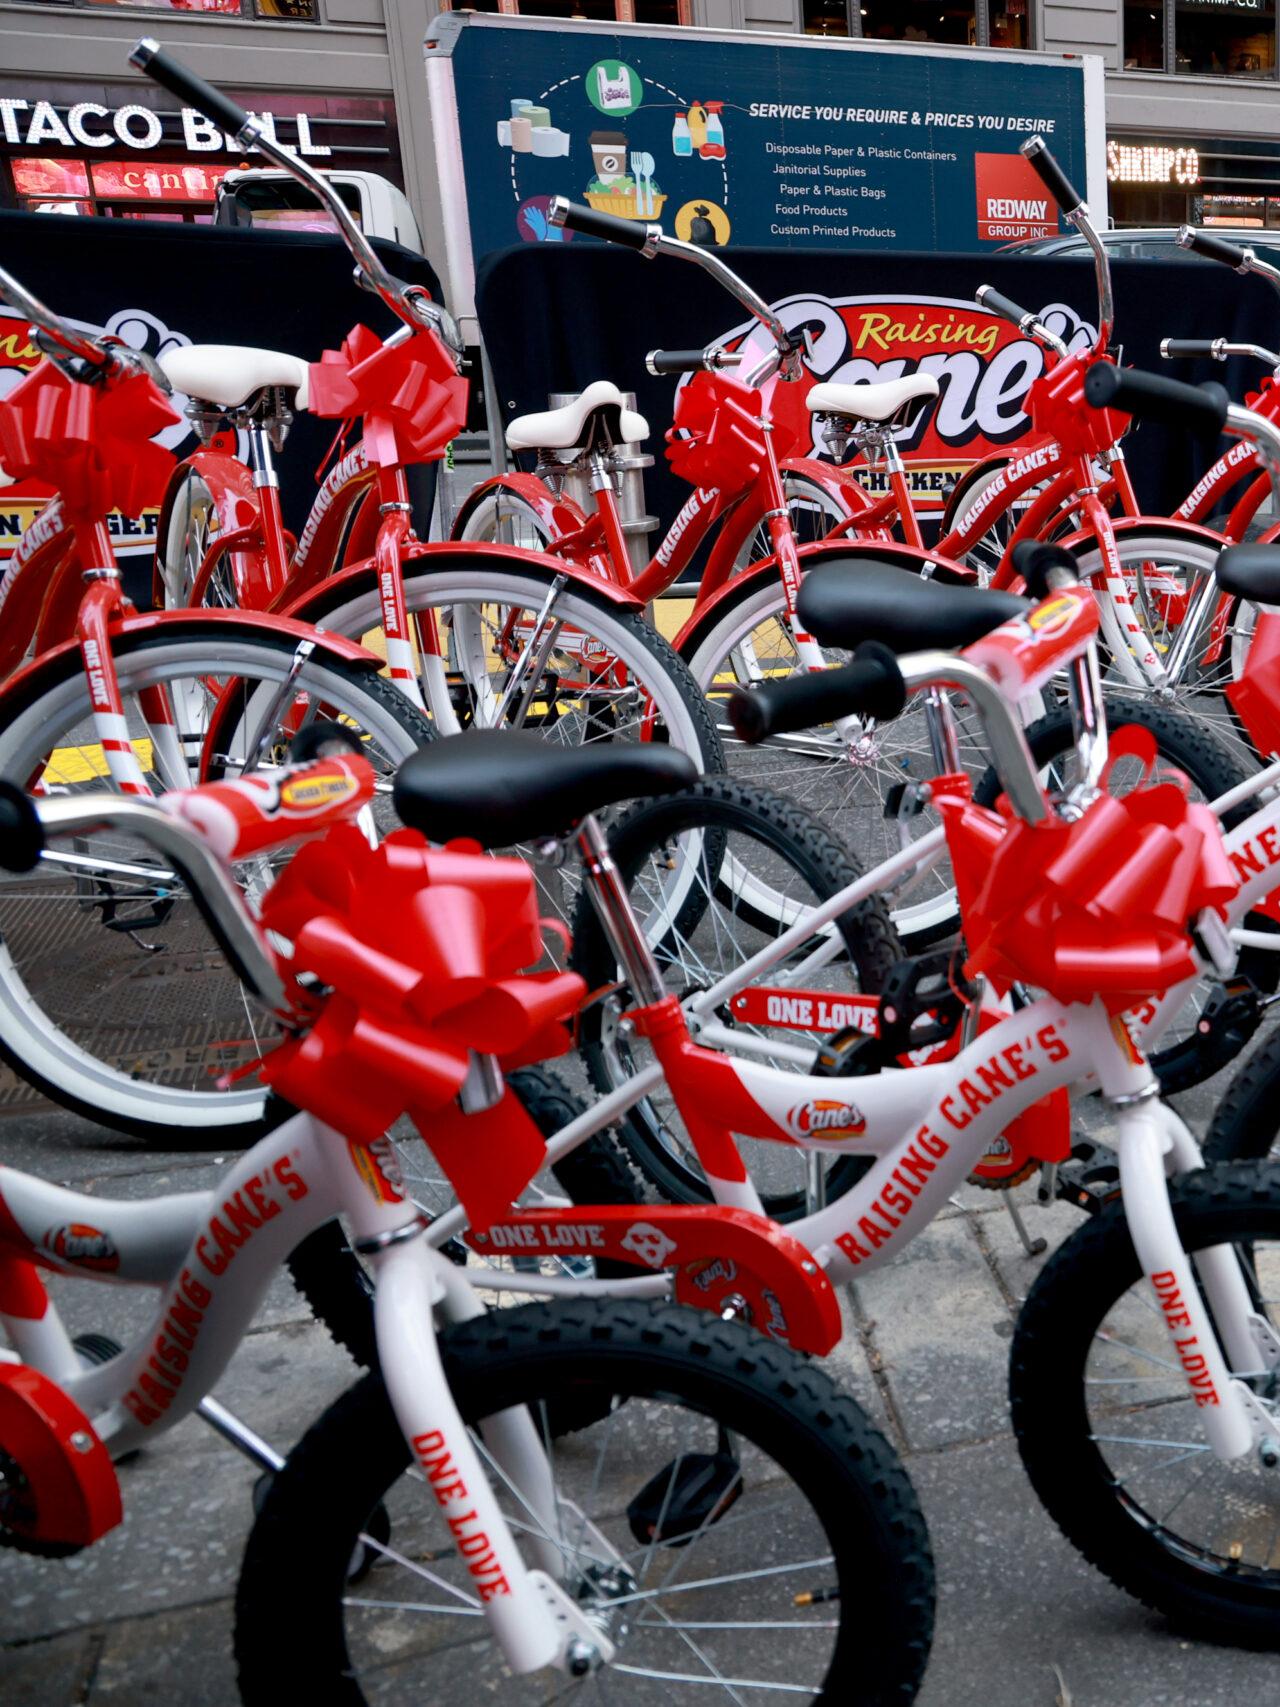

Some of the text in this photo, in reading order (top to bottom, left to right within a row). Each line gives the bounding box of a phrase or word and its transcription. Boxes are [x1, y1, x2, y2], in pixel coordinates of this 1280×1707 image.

[0, 99, 163, 150] TACO
[749, 103, 1056, 133] SERVICE YOU REQUIRE & PRICES YOU DESIRE
[765, 142, 957, 161] Disposable Paper & Plastic Containers
[773, 163, 866, 178] Janitorial Supplies
[1107, 141, 1199, 184] SHRIMP CO
[775, 204, 848, 216] Food Products
[780, 184, 886, 199] Paper & Plastic Bags
[987, 199, 1047, 220] REDWAY
[770, 224, 896, 238] Custom Printed Products
[988, 225, 1027, 238] GROUP
[855, 312, 999, 355] Raising
[956, 443, 1061, 538] RAISING CANE'S
[1178, 461, 1229, 519] RAISING
[655, 496, 702, 568] RAISING
[1102, 531, 1119, 577] ONE LOVE
[380, 572, 399, 632] ONE LOVE
[83, 639, 109, 706] ONE LOVE
[766, 995, 877, 1033] ONE LOVE
[792, 1099, 865, 1137] Cane's
[834, 1023, 1071, 1266] RAISING CANE'S
[490, 1224, 606, 1248] ONE LOVE
[122, 1153, 311, 1427] RAISING CANE'S
[1150, 1270, 1221, 1410] ONE LOVE
[411, 1429, 514, 1602] ONE LOVE
